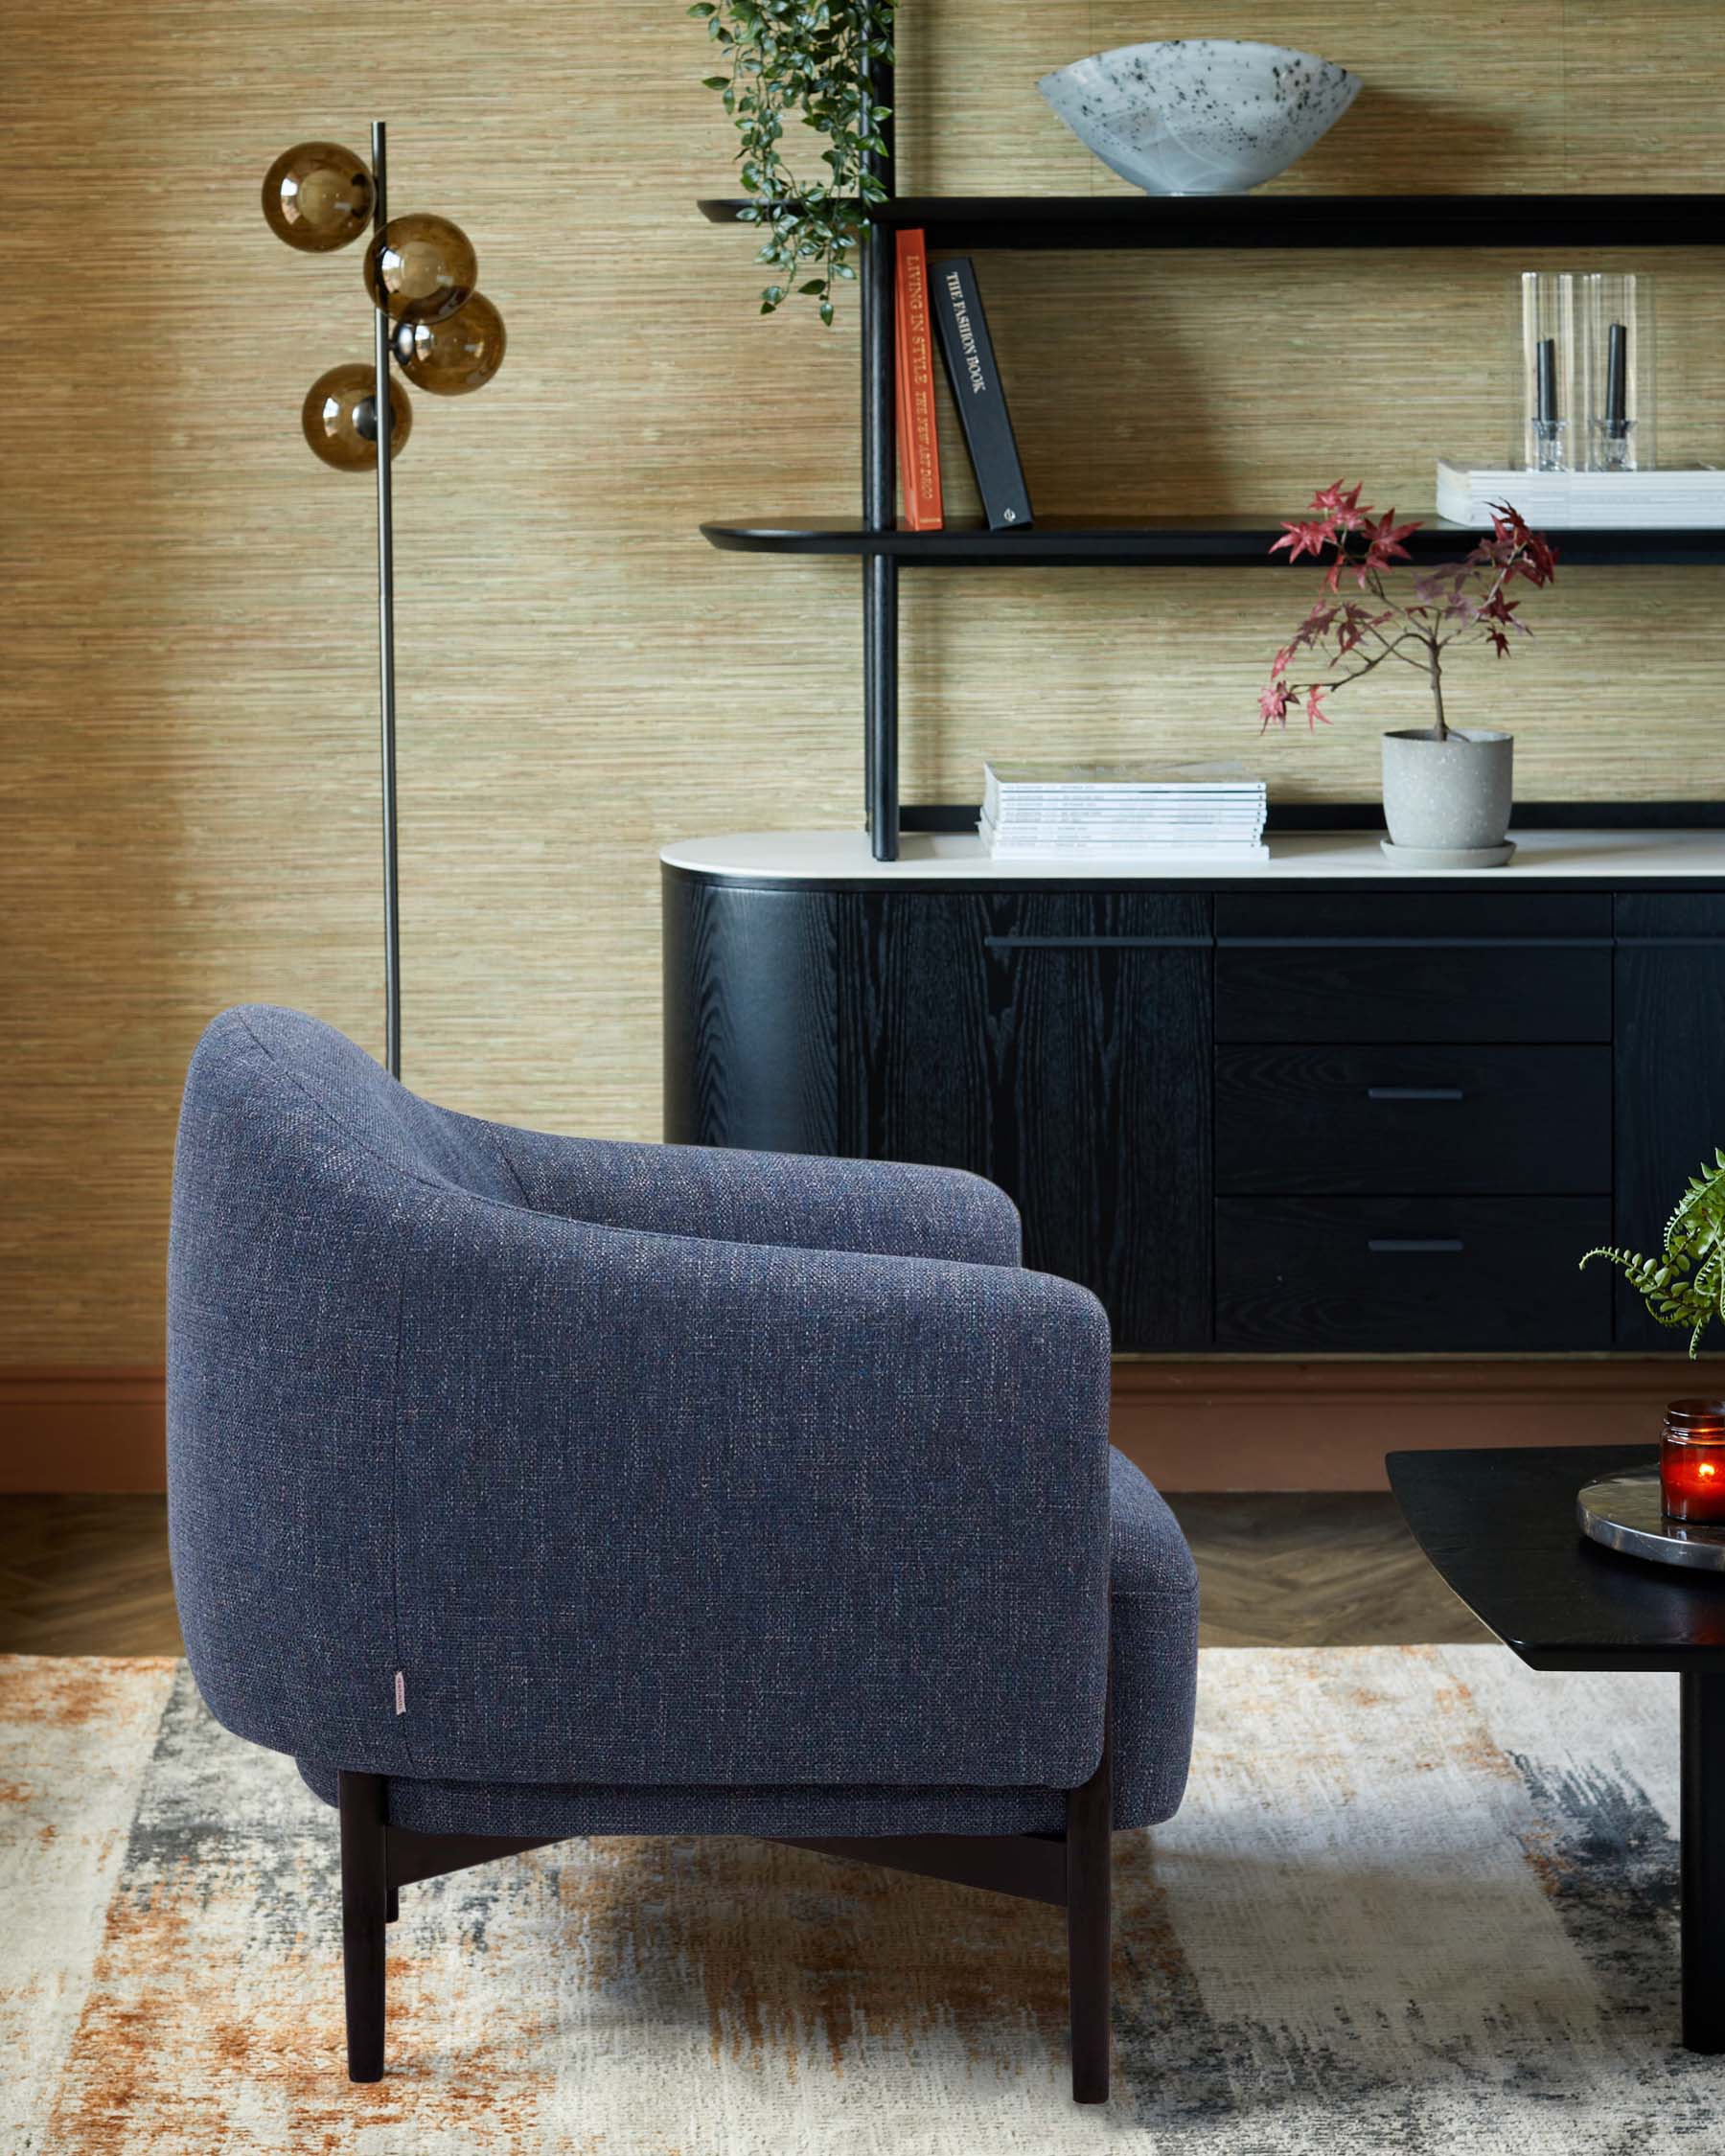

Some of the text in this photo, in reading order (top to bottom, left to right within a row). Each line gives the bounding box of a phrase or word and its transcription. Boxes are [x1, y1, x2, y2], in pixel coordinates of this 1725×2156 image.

[906, 255, 923, 310] LIVING
[910, 314, 925, 333] IN
[945, 271, 987, 394] THE FASHION BOOK
[911, 335, 929, 383] STYLE
